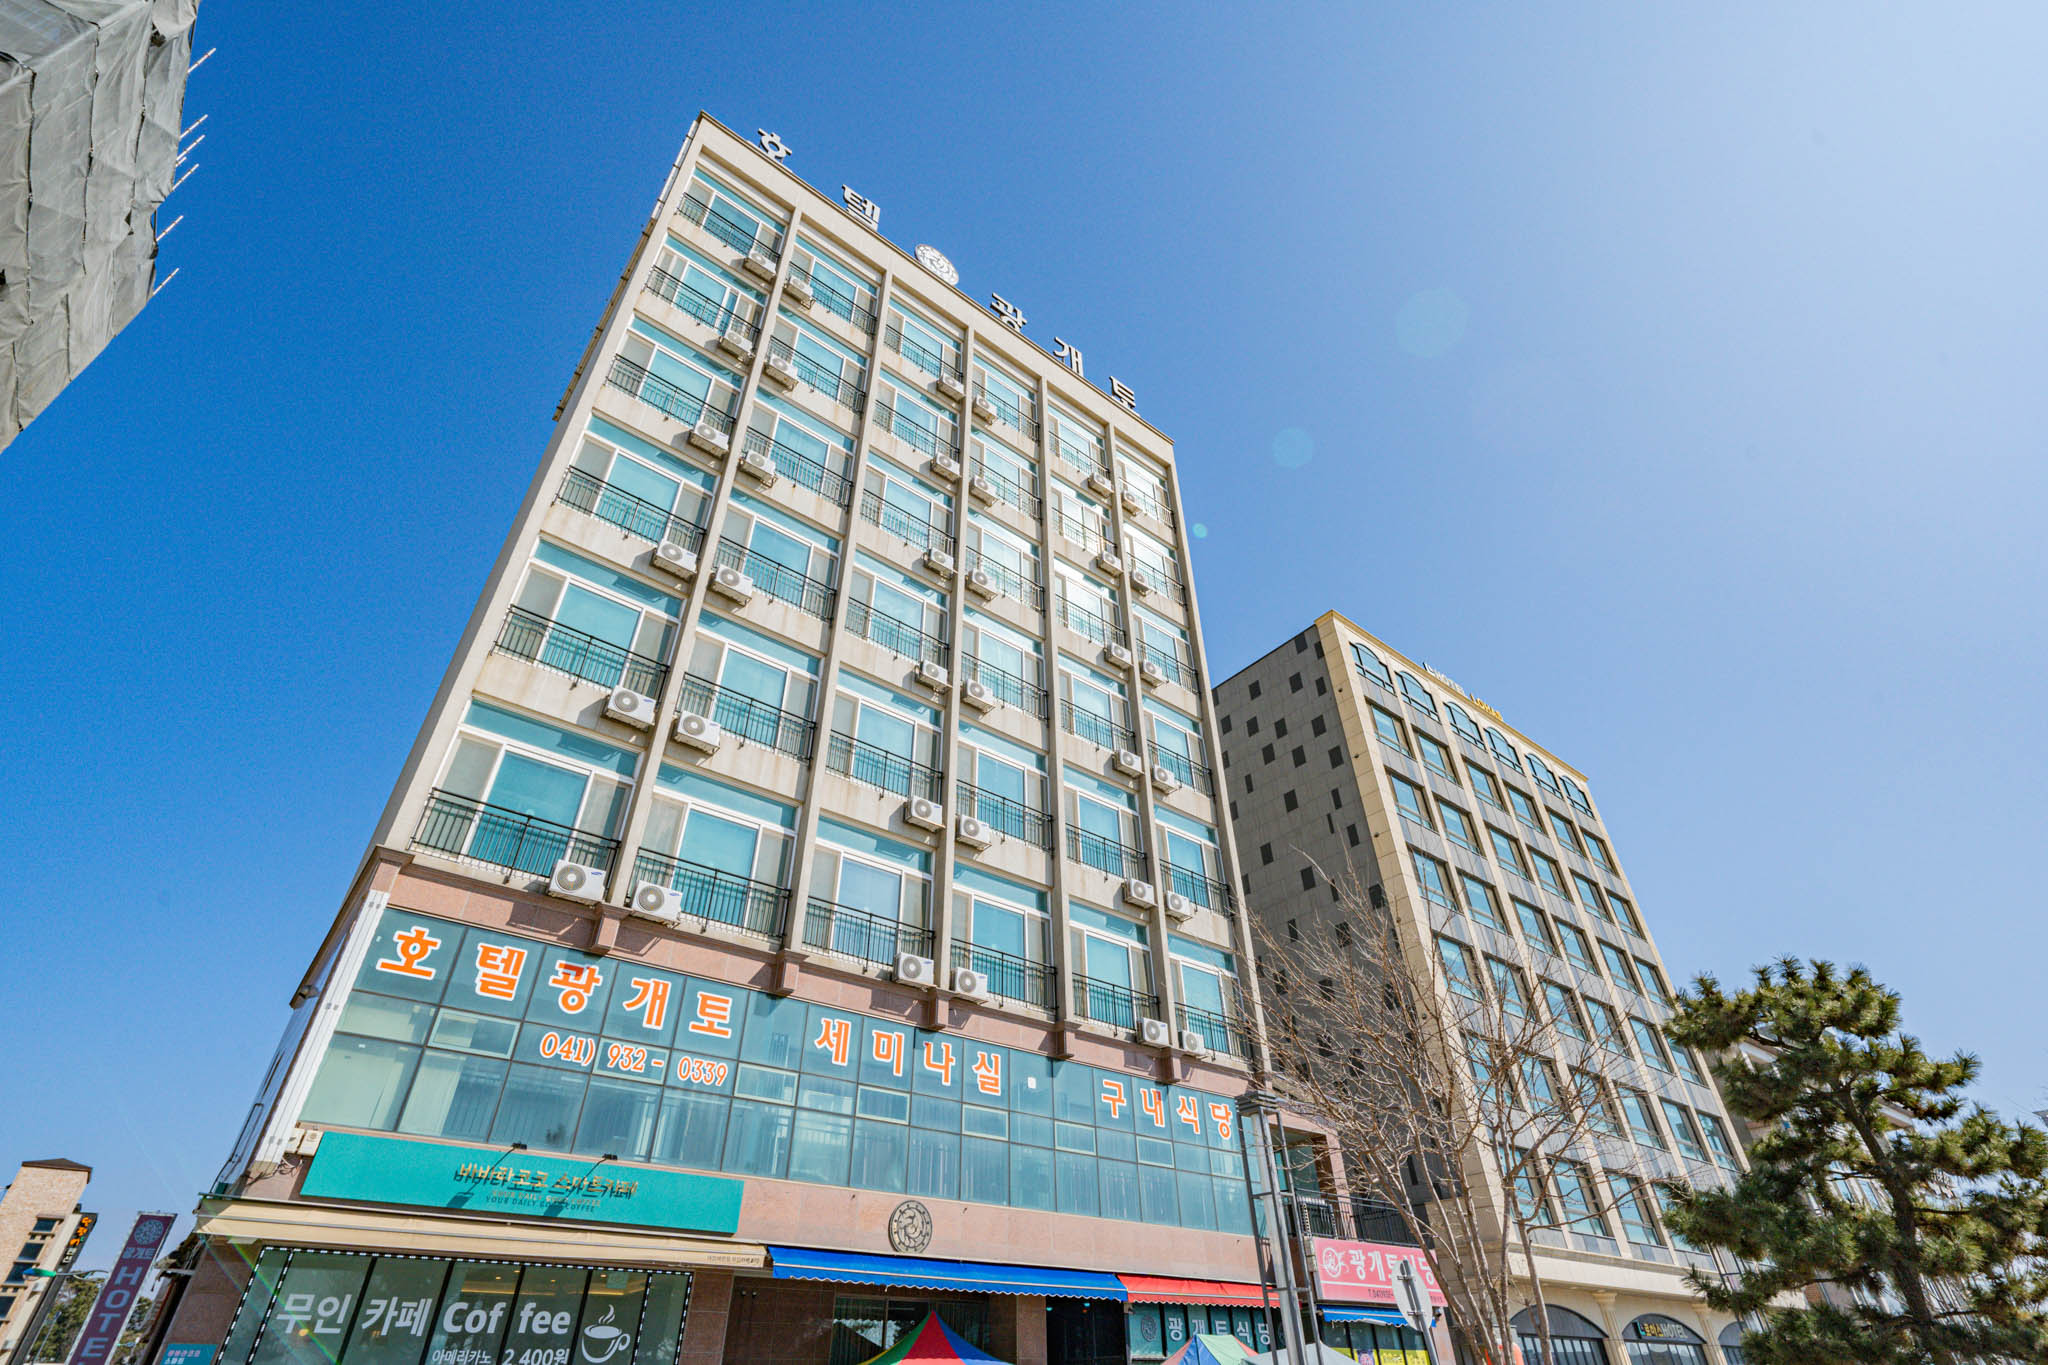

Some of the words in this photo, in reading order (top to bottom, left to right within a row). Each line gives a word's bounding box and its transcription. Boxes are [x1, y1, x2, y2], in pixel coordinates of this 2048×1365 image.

[677, 1056, 729, 1087] 0339
[814, 1016, 1002, 1096] 세미나실
[1100, 1078, 1234, 1141] 구내식당
[76, 1265, 145, 1365] HOTE
[276, 1293, 353, 1336] 무인
[360, 1297, 434, 1337] 카페
[442, 1301, 505, 1335] Cof
[518, 1301, 571, 1335] fee
[431, 1348, 492, 1365] 아메리카노
[503, 1347, 570, 1365] 2400원
